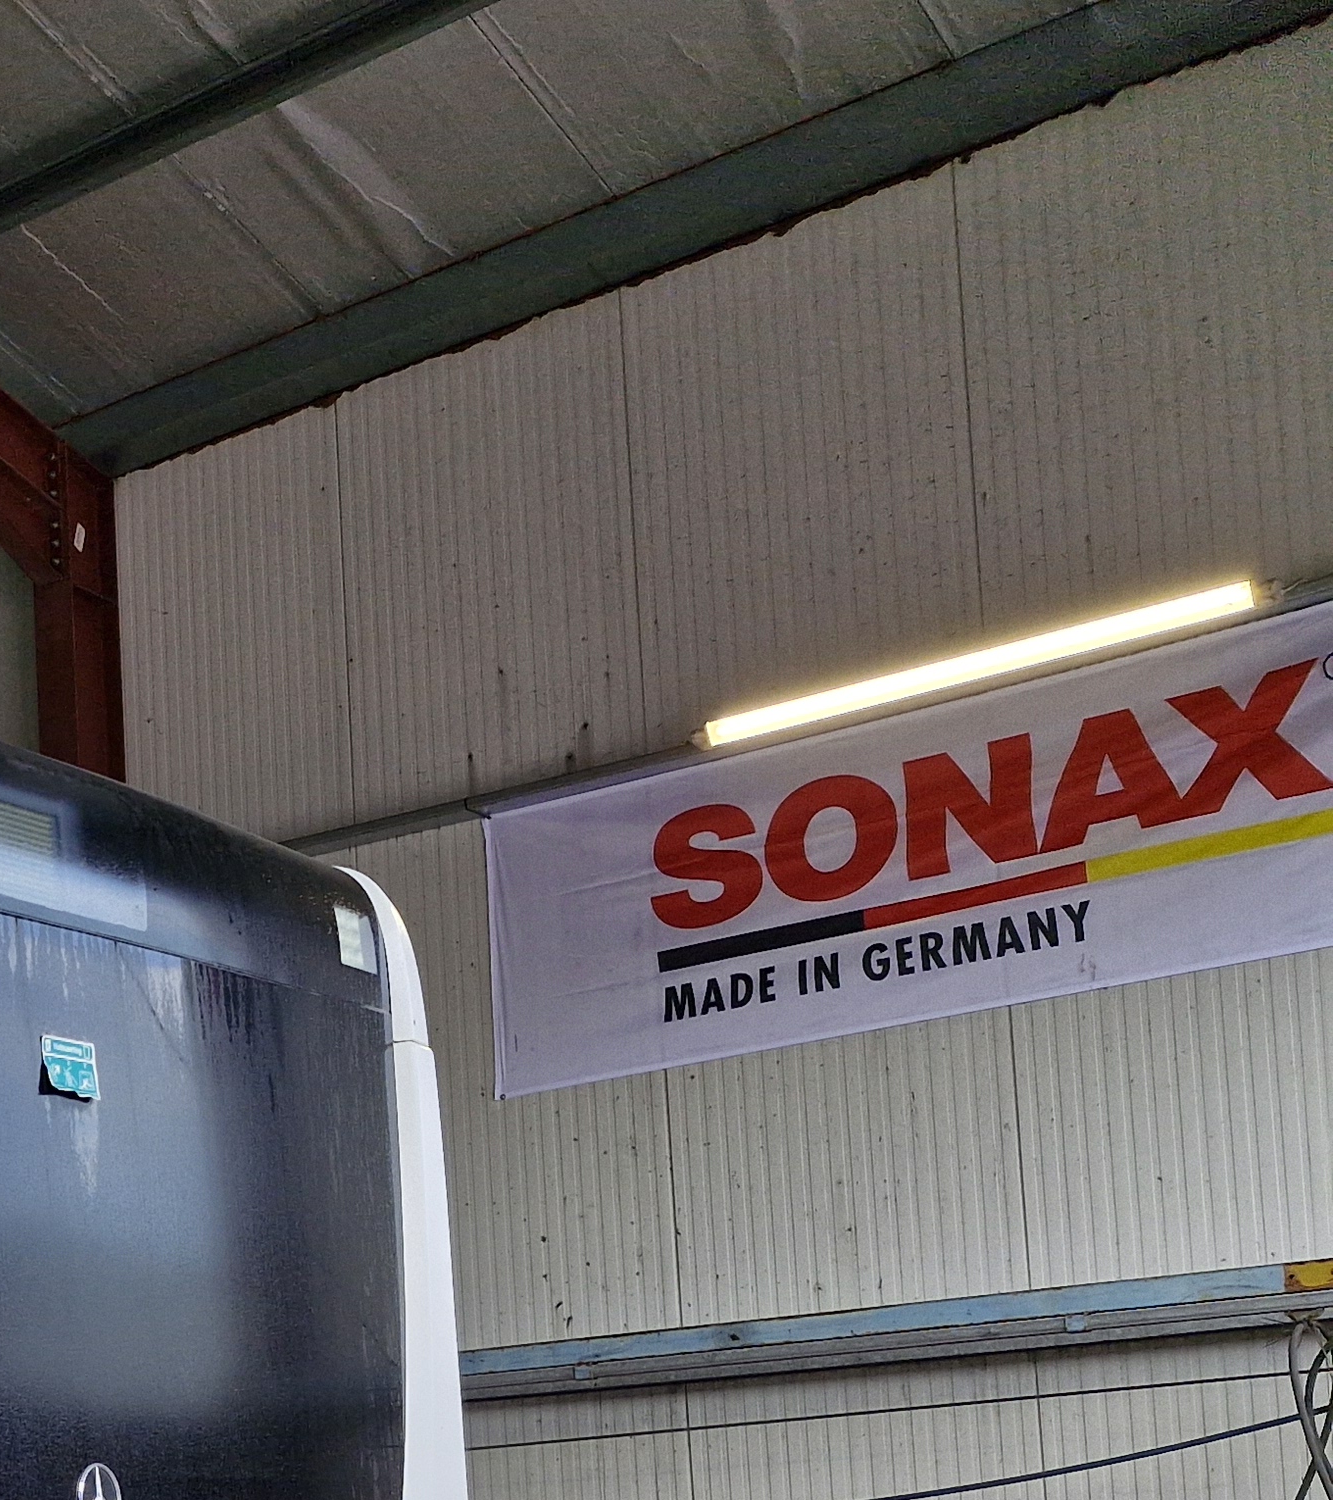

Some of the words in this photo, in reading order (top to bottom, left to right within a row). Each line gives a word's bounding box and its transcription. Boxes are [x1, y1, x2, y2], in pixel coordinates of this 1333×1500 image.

[649, 656, 1333, 930] SONAX
[663, 963, 778, 1023] MADE
[797, 950, 842, 997] IN
[861, 899, 1092, 982] GERMANY
